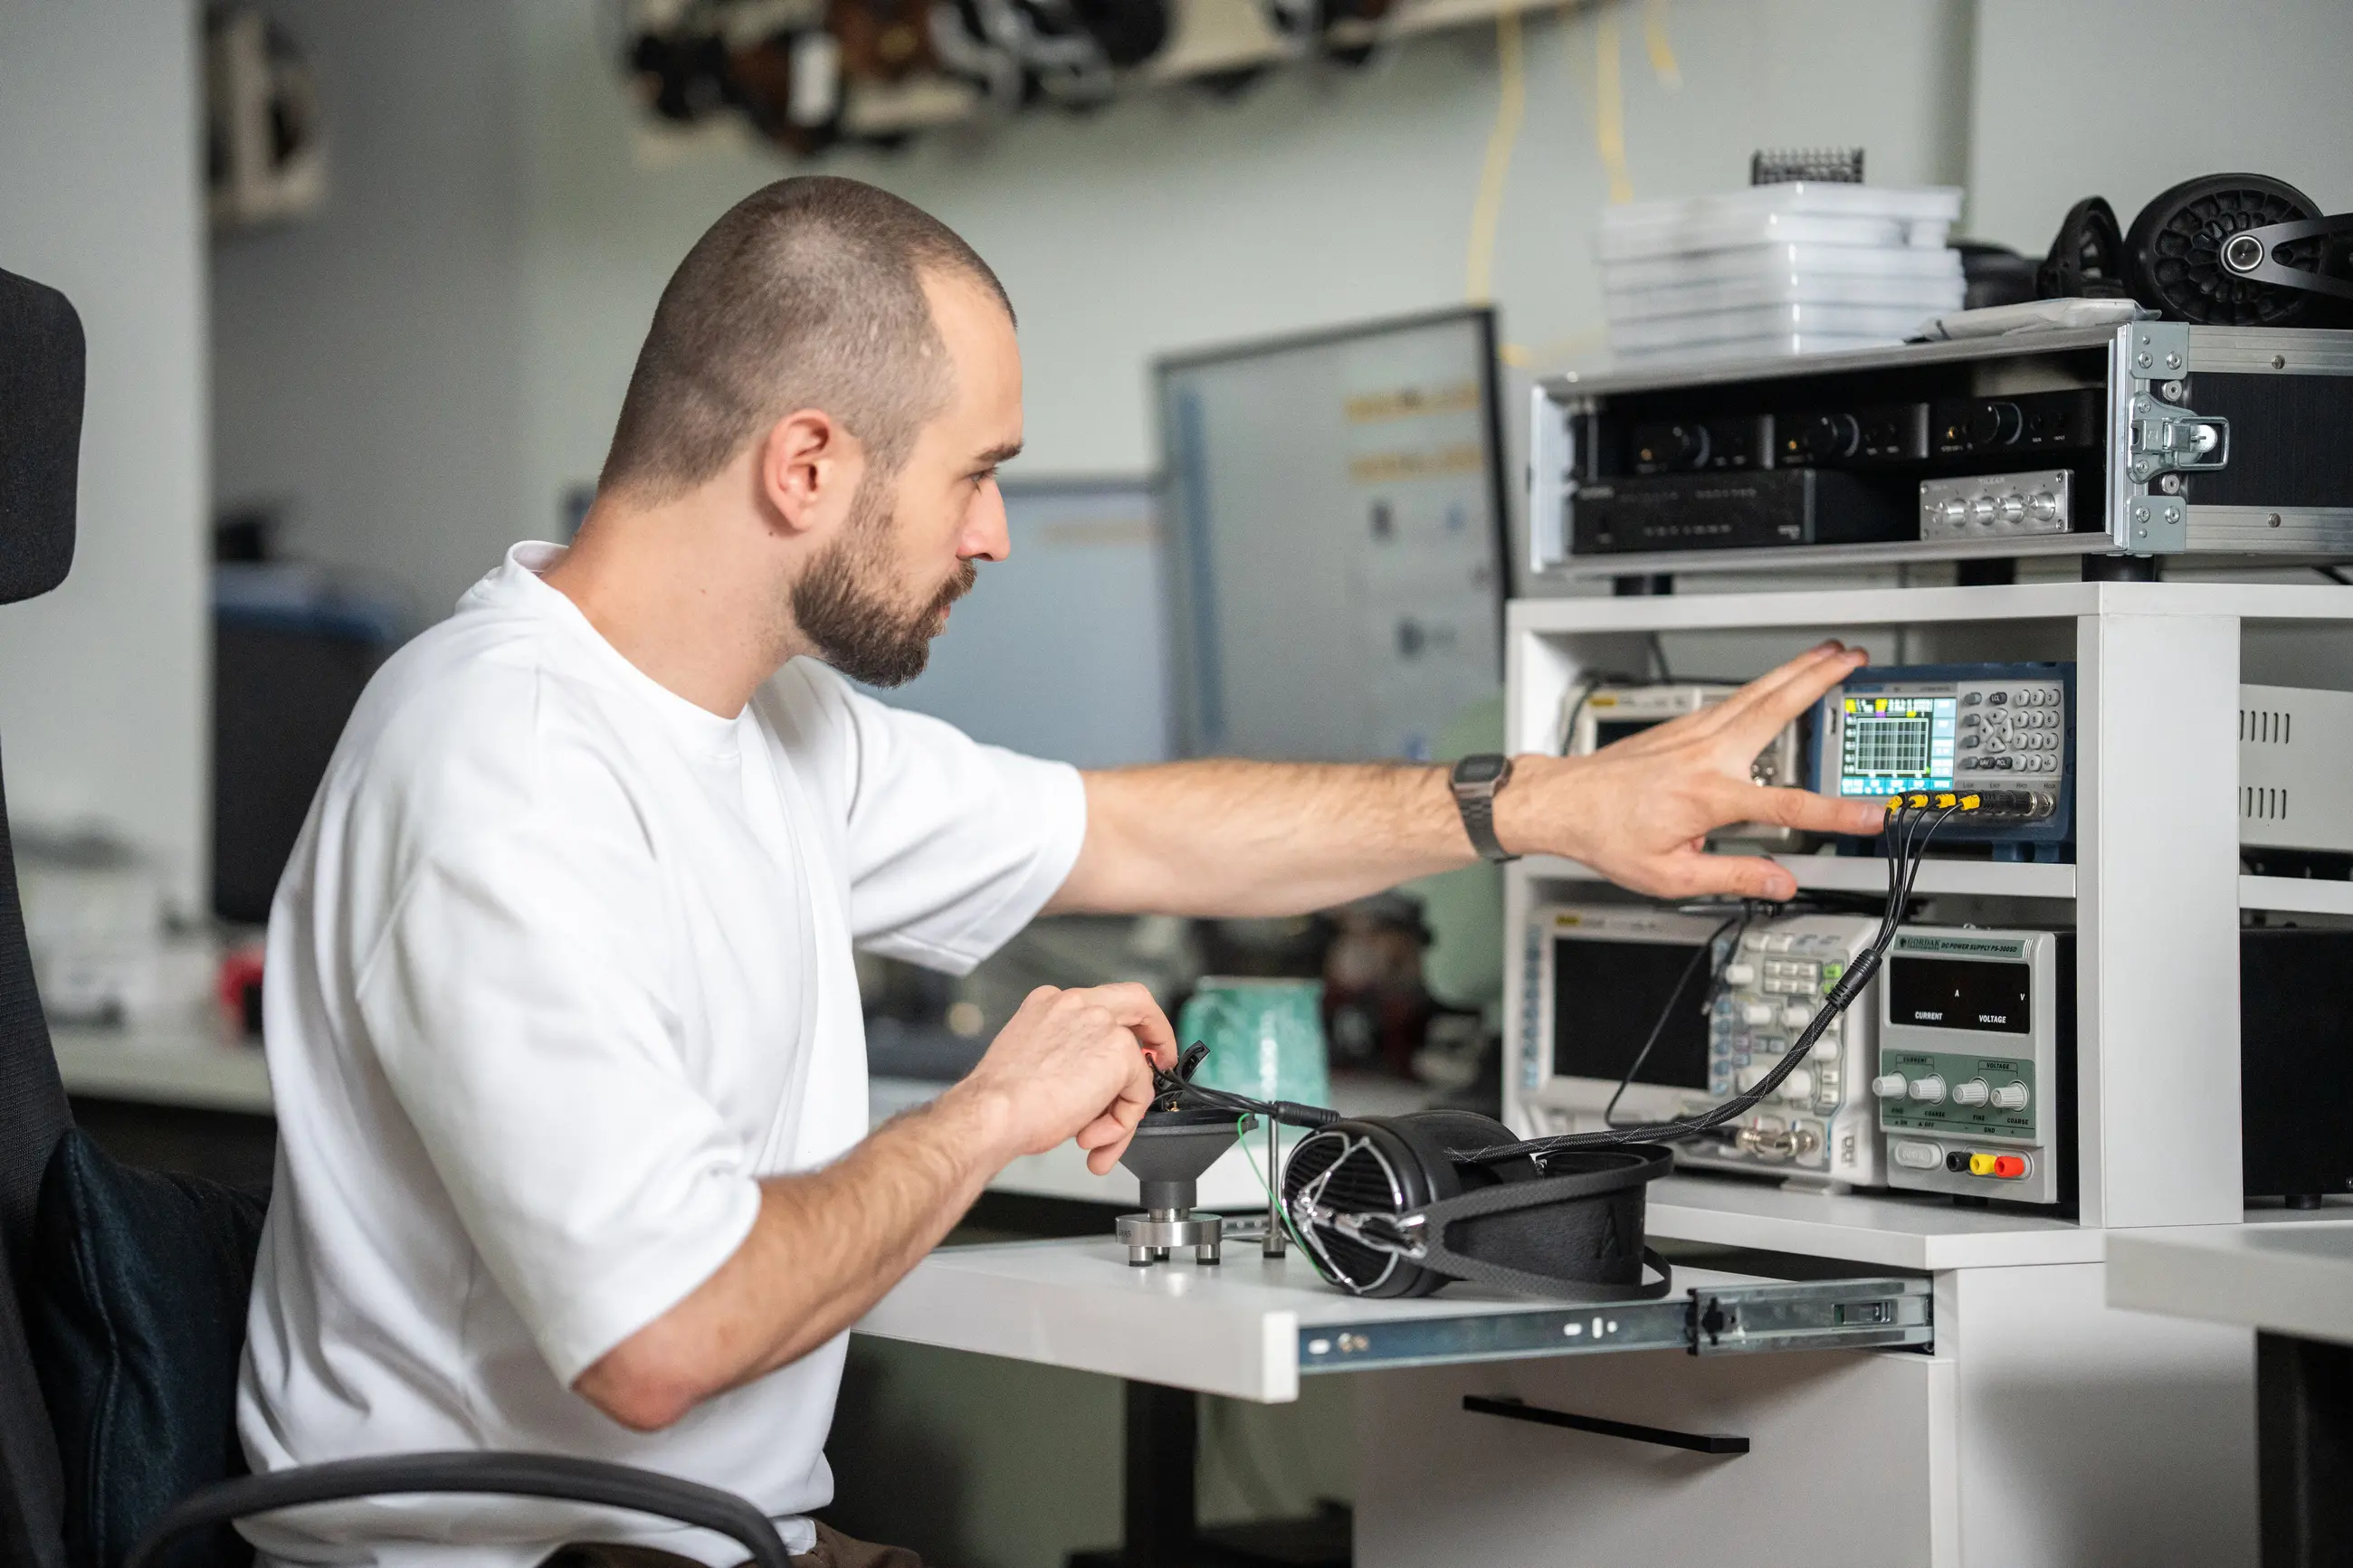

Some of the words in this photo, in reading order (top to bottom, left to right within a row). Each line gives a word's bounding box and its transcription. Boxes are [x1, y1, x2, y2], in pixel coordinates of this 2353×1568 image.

[1970, 944, 1991, 952] SUPPLY
[1954, 989, 1960, 997] A
[2020, 993, 2025, 1001] V
[1914, 1011, 1943, 1021] CURRENT
[1978, 1014, 2006, 1024] VOLTAGE
[1903, 1056, 1928, 1064] CURRENT
[1986, 1062, 2010, 1070] VOLTAGE
[1924, 1110, 1946, 1118] COARSE
[1972, 1114, 1986, 1122] FINE
[2006, 1117, 2029, 1126] COARSE
[1983, 1126, 1996, 1135] GND
